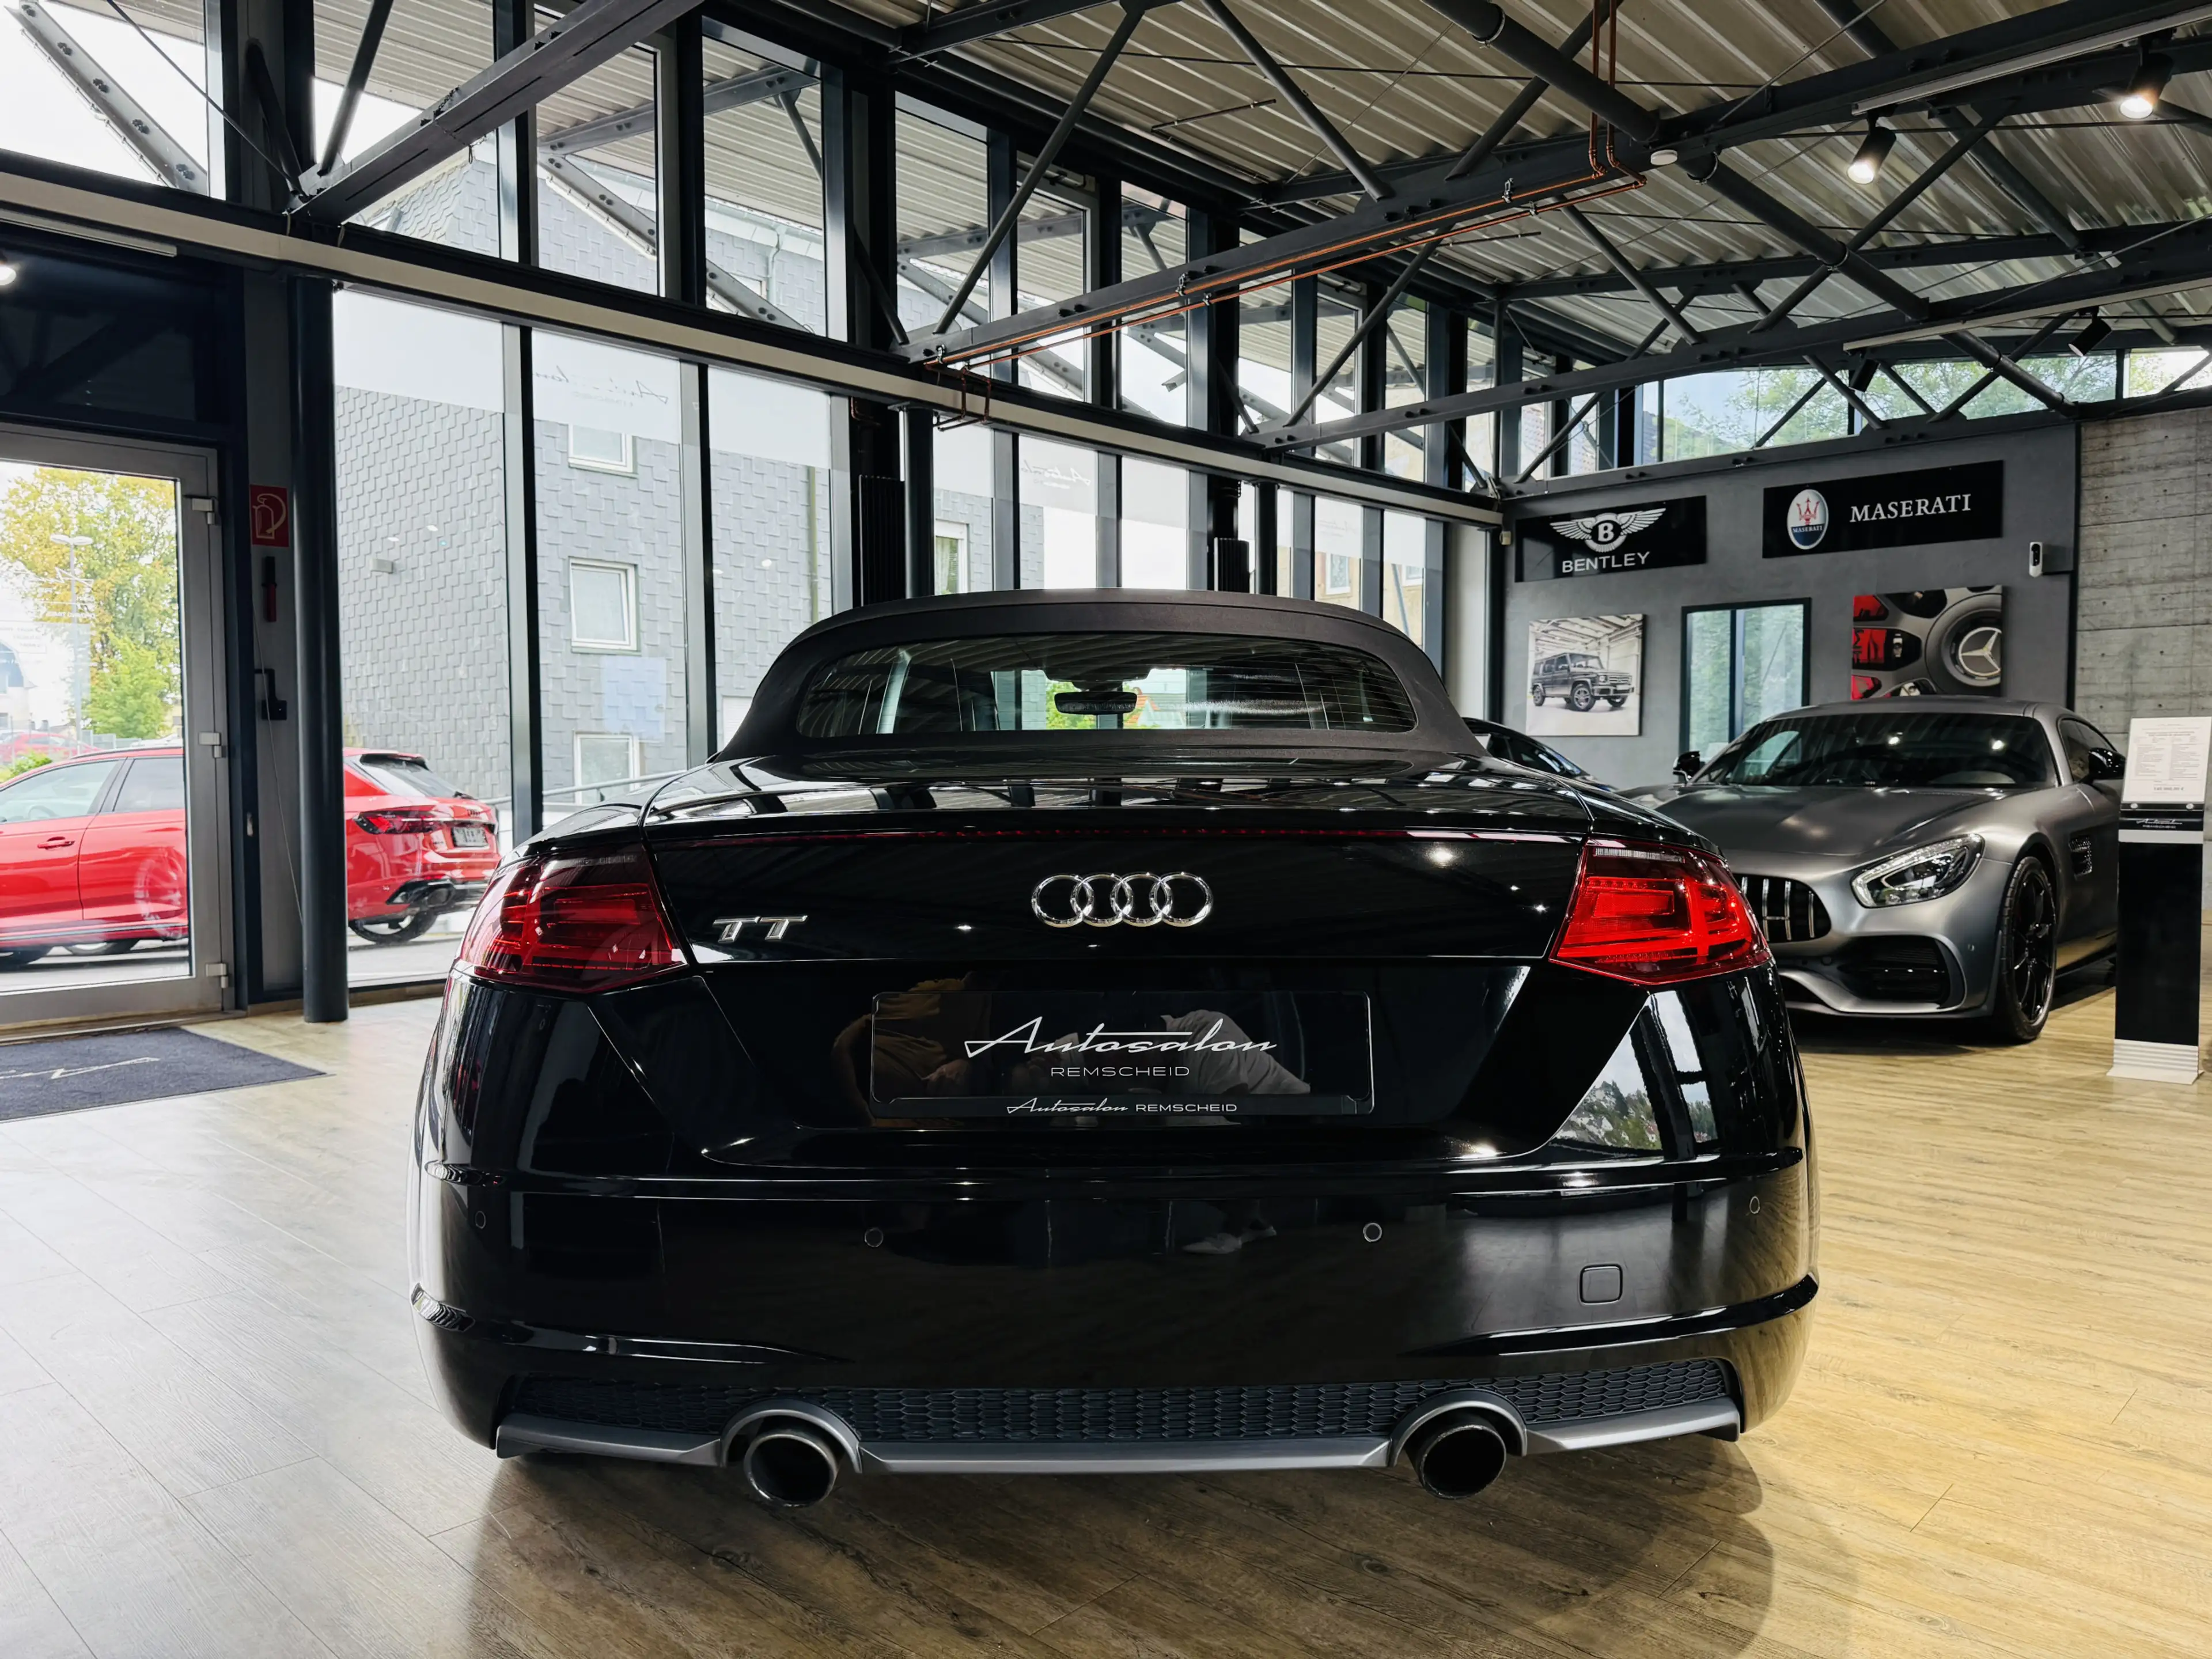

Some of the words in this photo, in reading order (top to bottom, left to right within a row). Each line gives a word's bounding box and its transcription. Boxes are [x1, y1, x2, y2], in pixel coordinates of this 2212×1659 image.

[1850, 494, 1971, 522] MASERATI
[1597, 522, 1615, 542] B
[1792, 525, 1823, 533] MASERATI
[1562, 551, 1650, 573] BENTLEY
[713, 915, 808, 942] TT
[964, 1016, 1277, 1058] Autosalon
[1051, 1066, 1190, 1077] REMSCHEID
[1006, 1097, 1128, 1114] Autosalon
[1135, 1104, 1237, 1112] REMSCHEID
